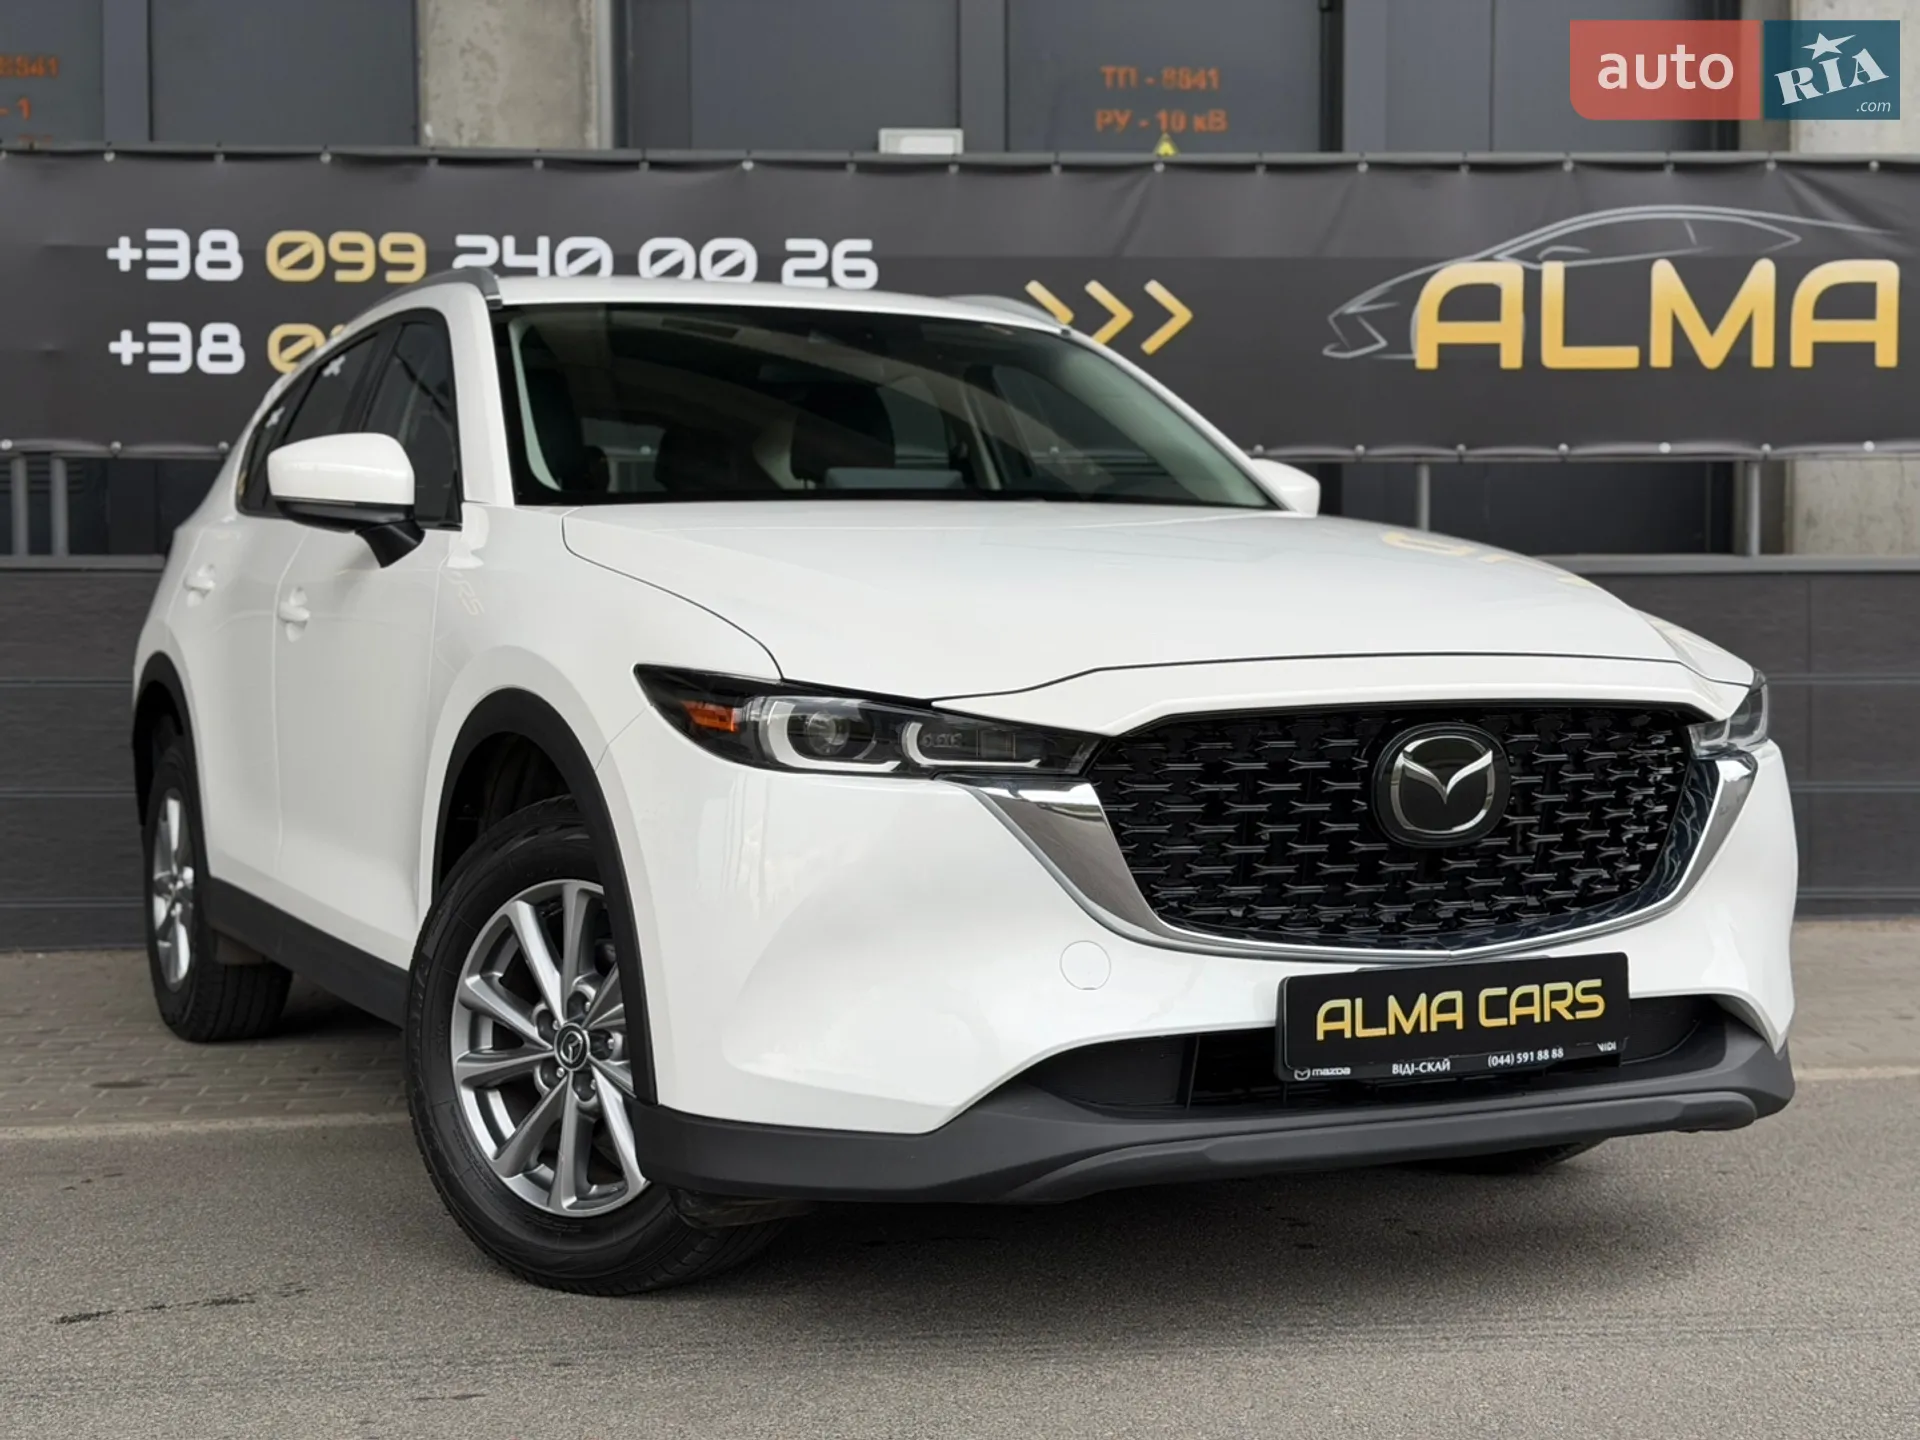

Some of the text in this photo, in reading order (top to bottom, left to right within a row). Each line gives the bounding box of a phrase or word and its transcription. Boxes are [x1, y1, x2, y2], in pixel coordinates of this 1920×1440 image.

[1156, 108, 1188, 133] 10
[106, 229, 880, 290] +38 099 240 00 26
[1415, 257, 1901, 370] ALMA
[108, 322, 246, 374] +38
[1316, 978, 1606, 1041] ALMA CARS
[1312, 1067, 1351, 1077] mazda
[1392, 1058, 1451, 1076] ВІДІ-СКАЙ
[1488, 1046, 1564, 1068] (044) 591 88 88
